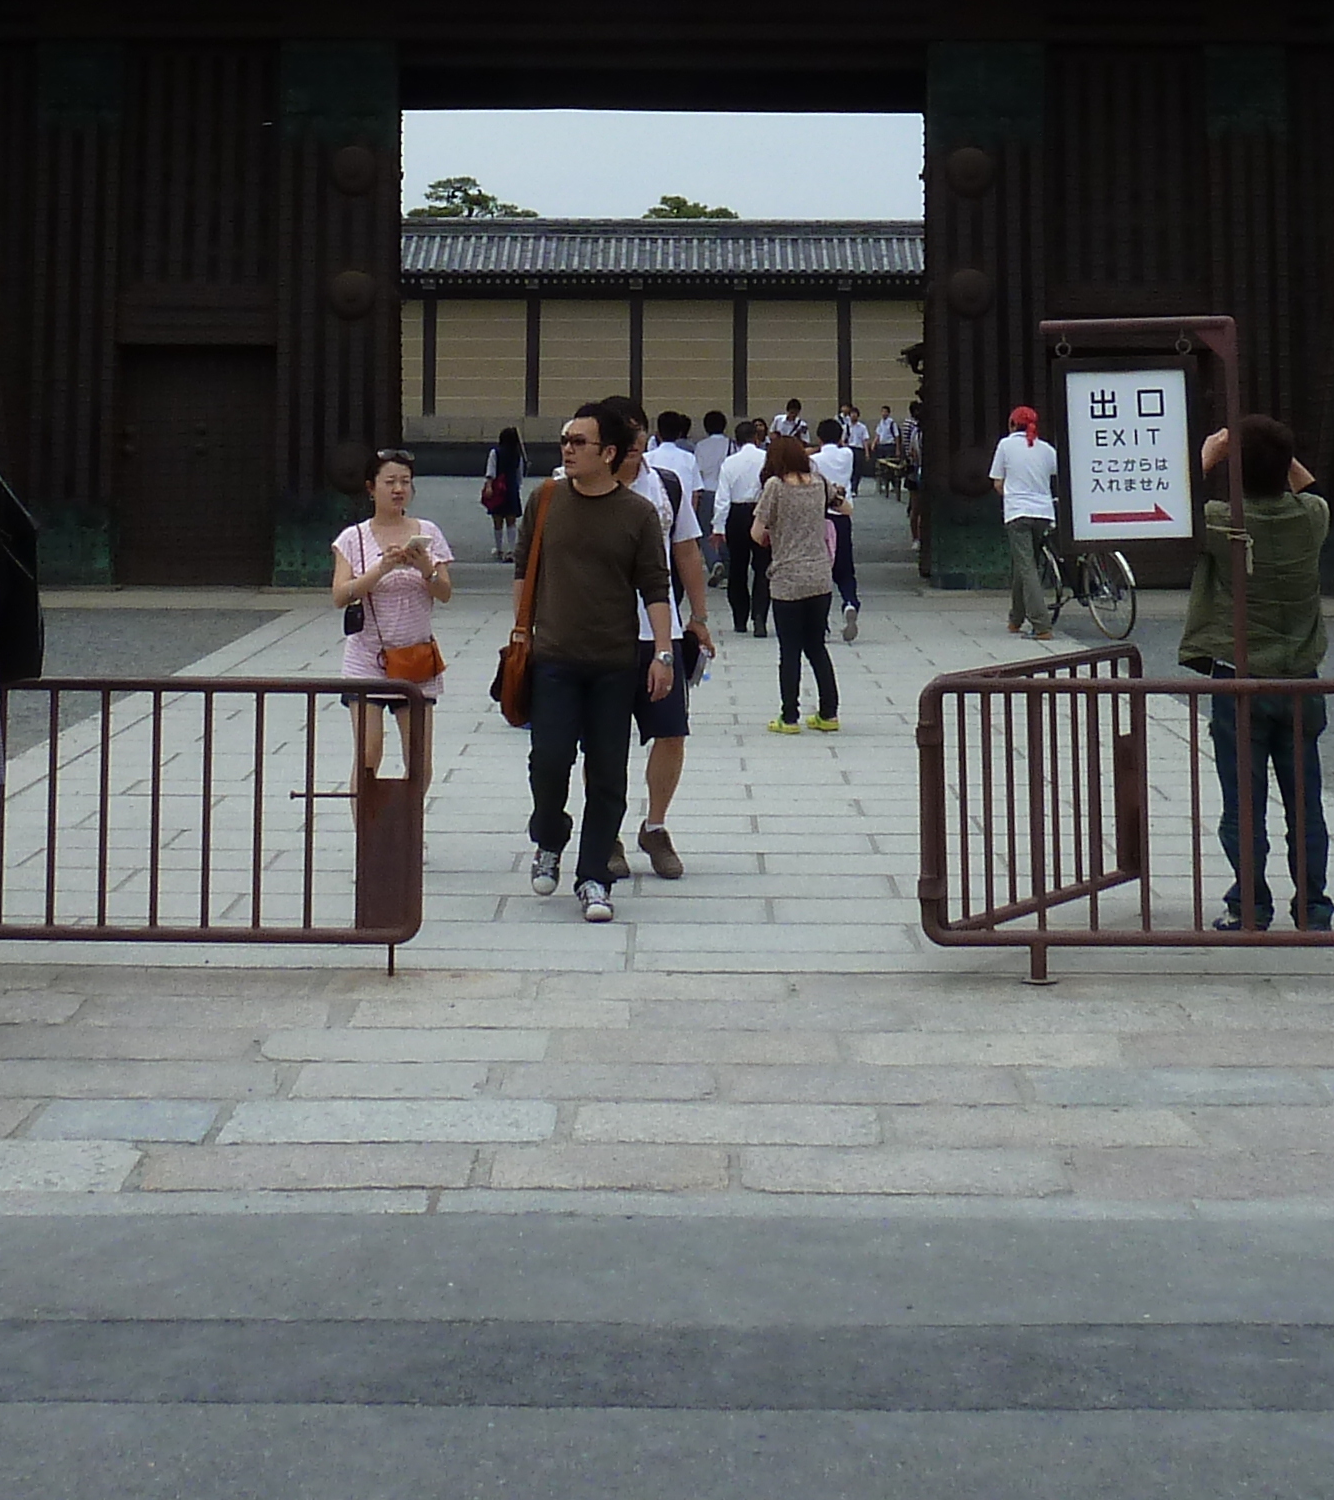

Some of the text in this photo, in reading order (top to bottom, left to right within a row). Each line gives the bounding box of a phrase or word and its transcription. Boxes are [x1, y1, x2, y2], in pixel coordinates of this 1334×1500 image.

[1090, 389, 1164, 419] 出口
[1095, 428, 1160, 447] EXIT
[1091, 458, 1168, 473] ここからは
[1091, 477, 1169, 493] 入れません
